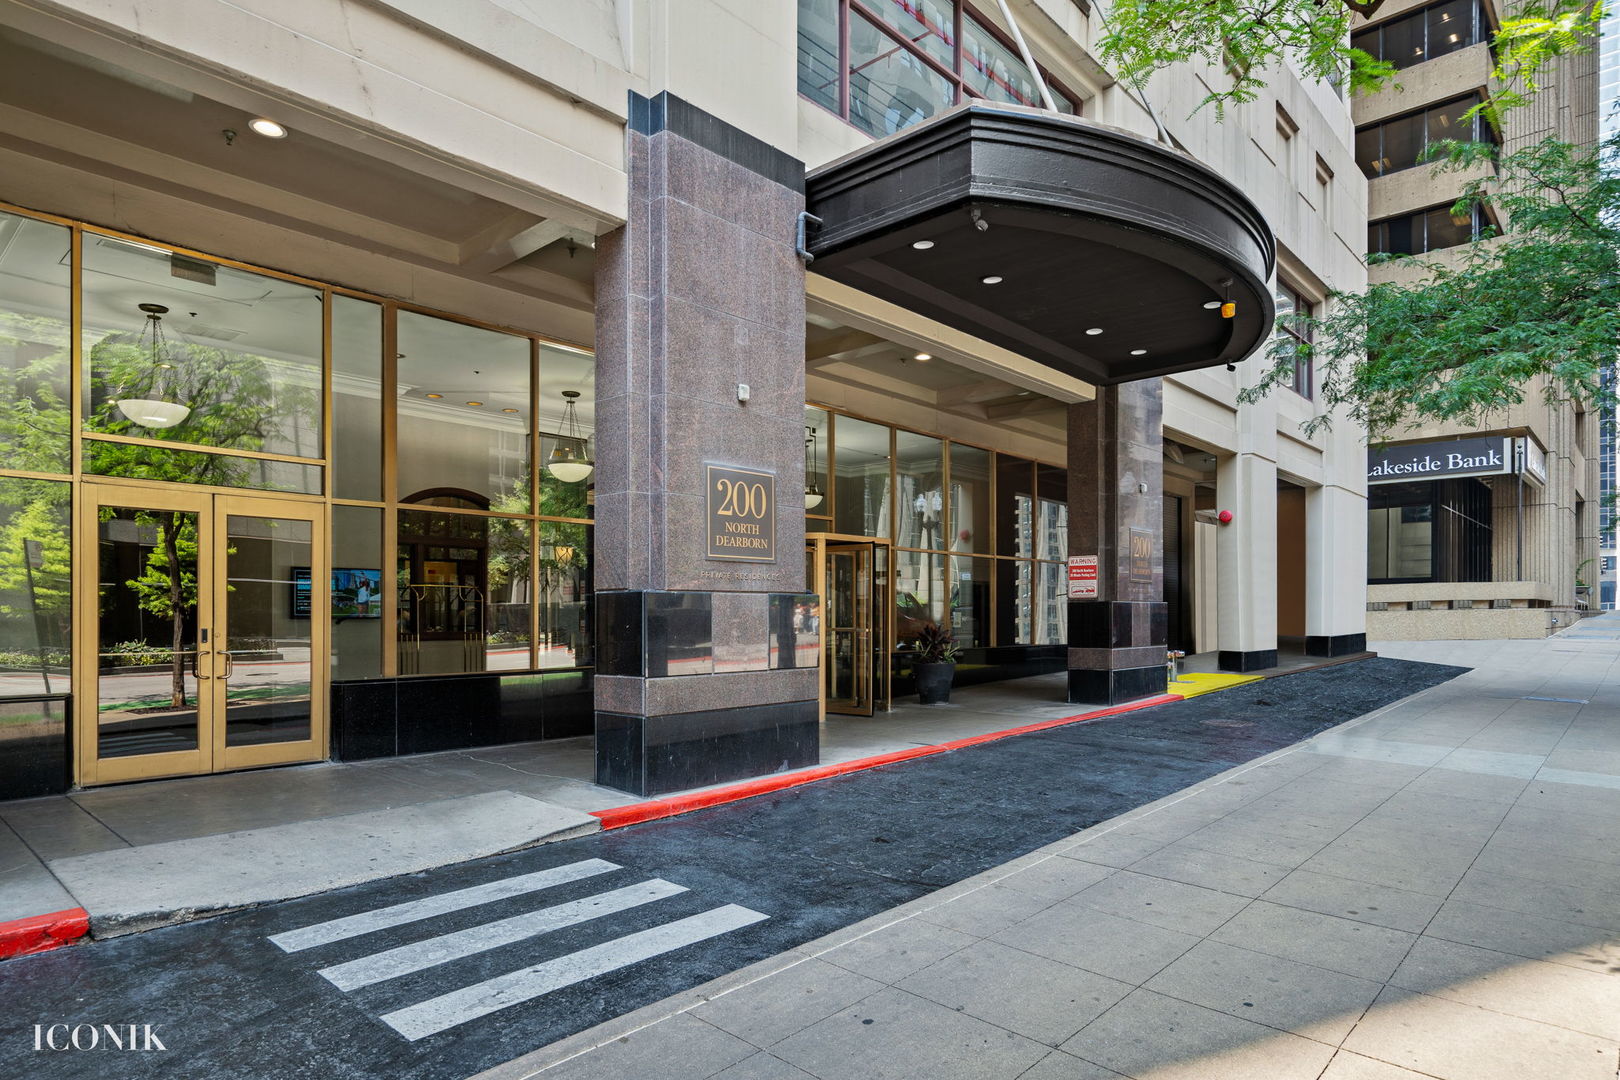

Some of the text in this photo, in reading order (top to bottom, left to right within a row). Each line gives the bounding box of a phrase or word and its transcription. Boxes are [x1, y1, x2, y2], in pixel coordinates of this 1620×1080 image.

[1446, 450, 1502, 470] Bank
[717, 479, 767, 519] 200
[725, 521, 760, 535] NORTH
[715, 535, 768, 549] DEARBORN
[1134, 535, 1151, 559] 200
[700, 570, 732, 580] PRIVATE
